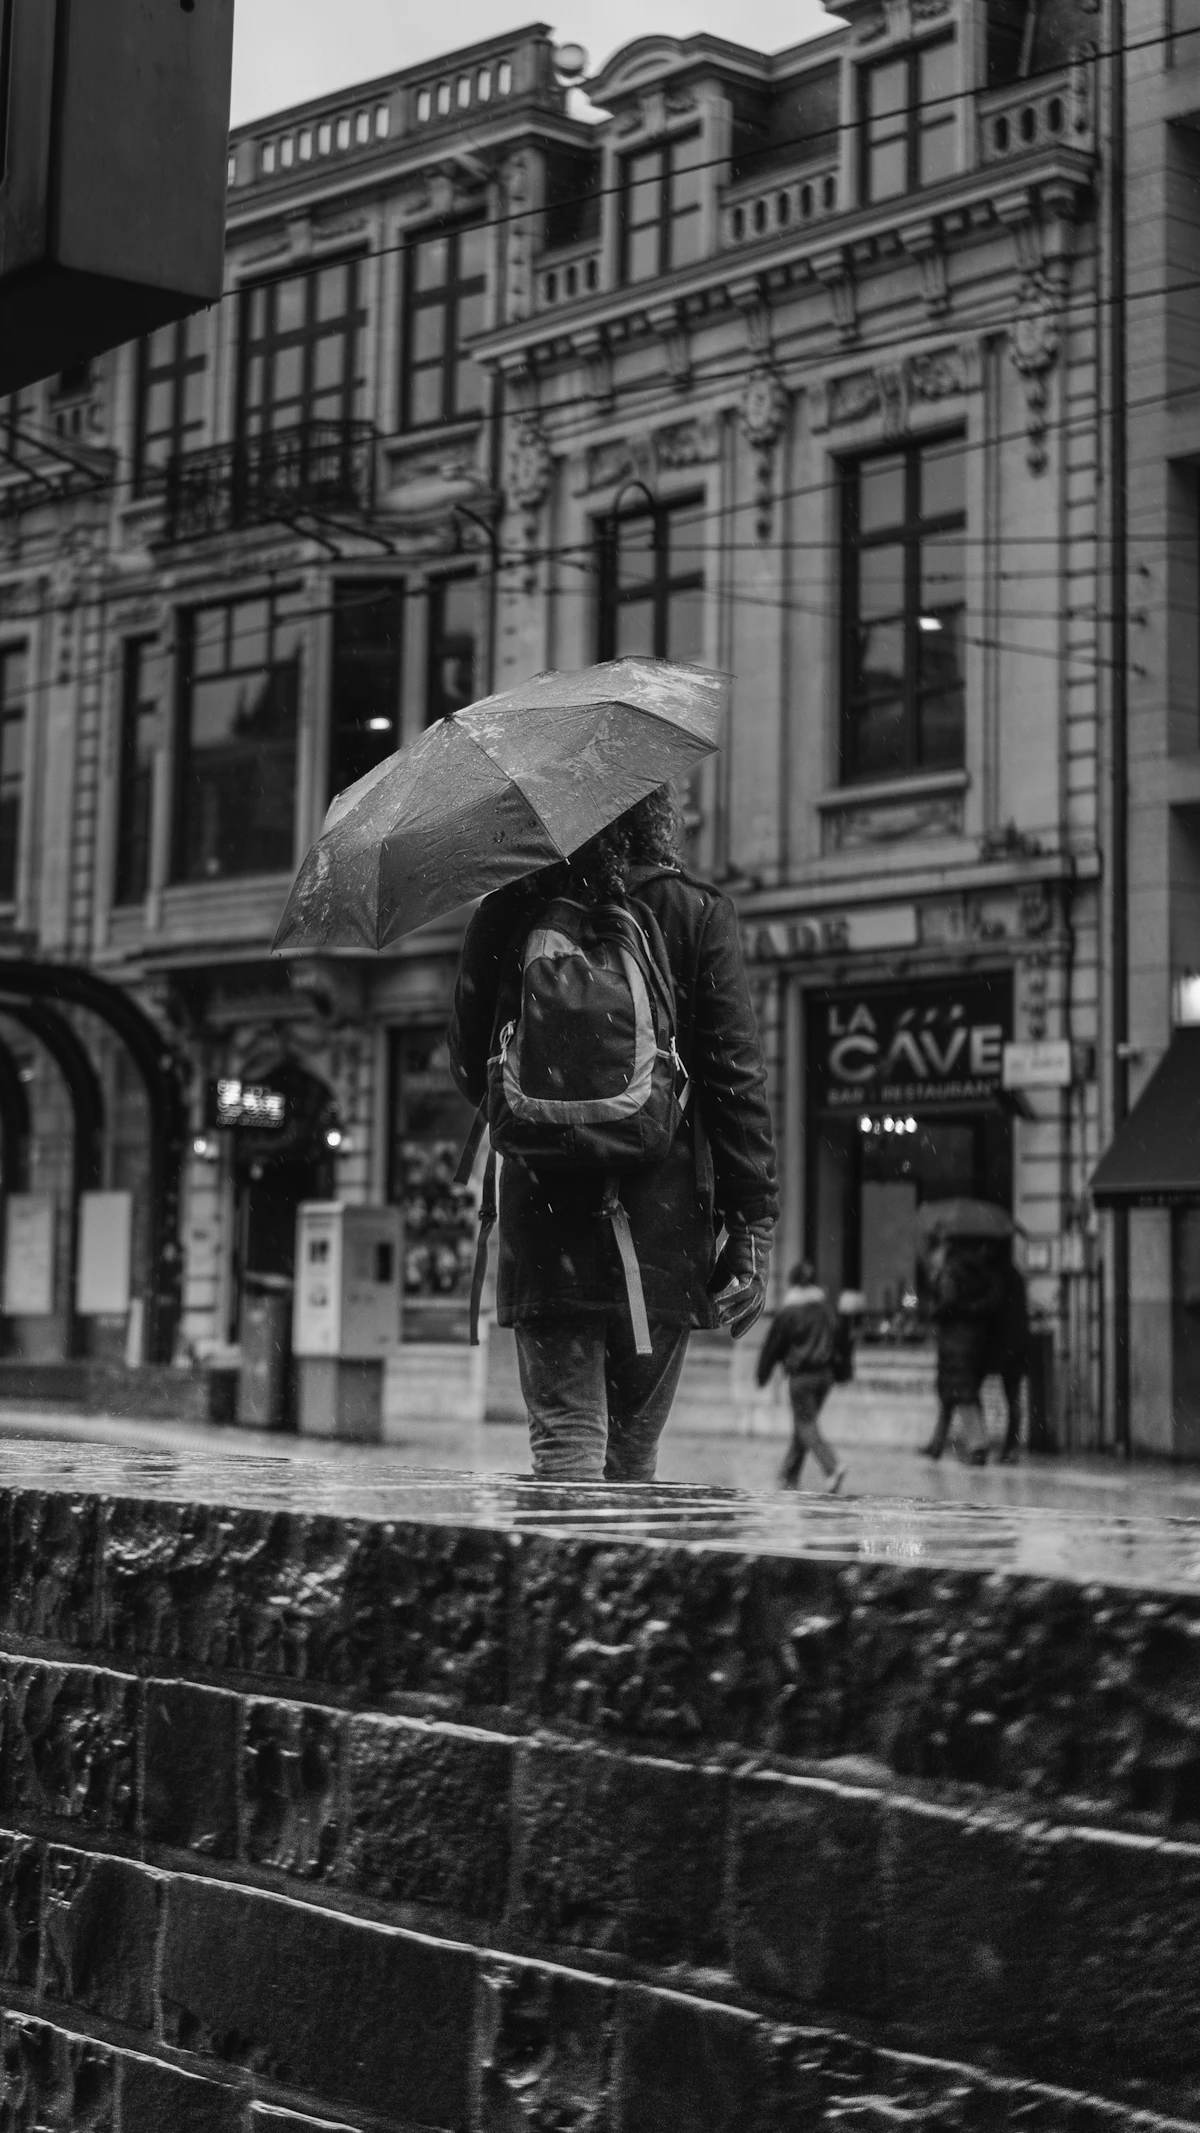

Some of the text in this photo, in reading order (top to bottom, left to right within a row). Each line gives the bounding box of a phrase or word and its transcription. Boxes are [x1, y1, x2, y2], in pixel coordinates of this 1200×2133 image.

[828, 1004, 877, 1036] LA
[828, 1023, 1002, 1082] CAVE
[827, 1086, 865, 1106] BAR
